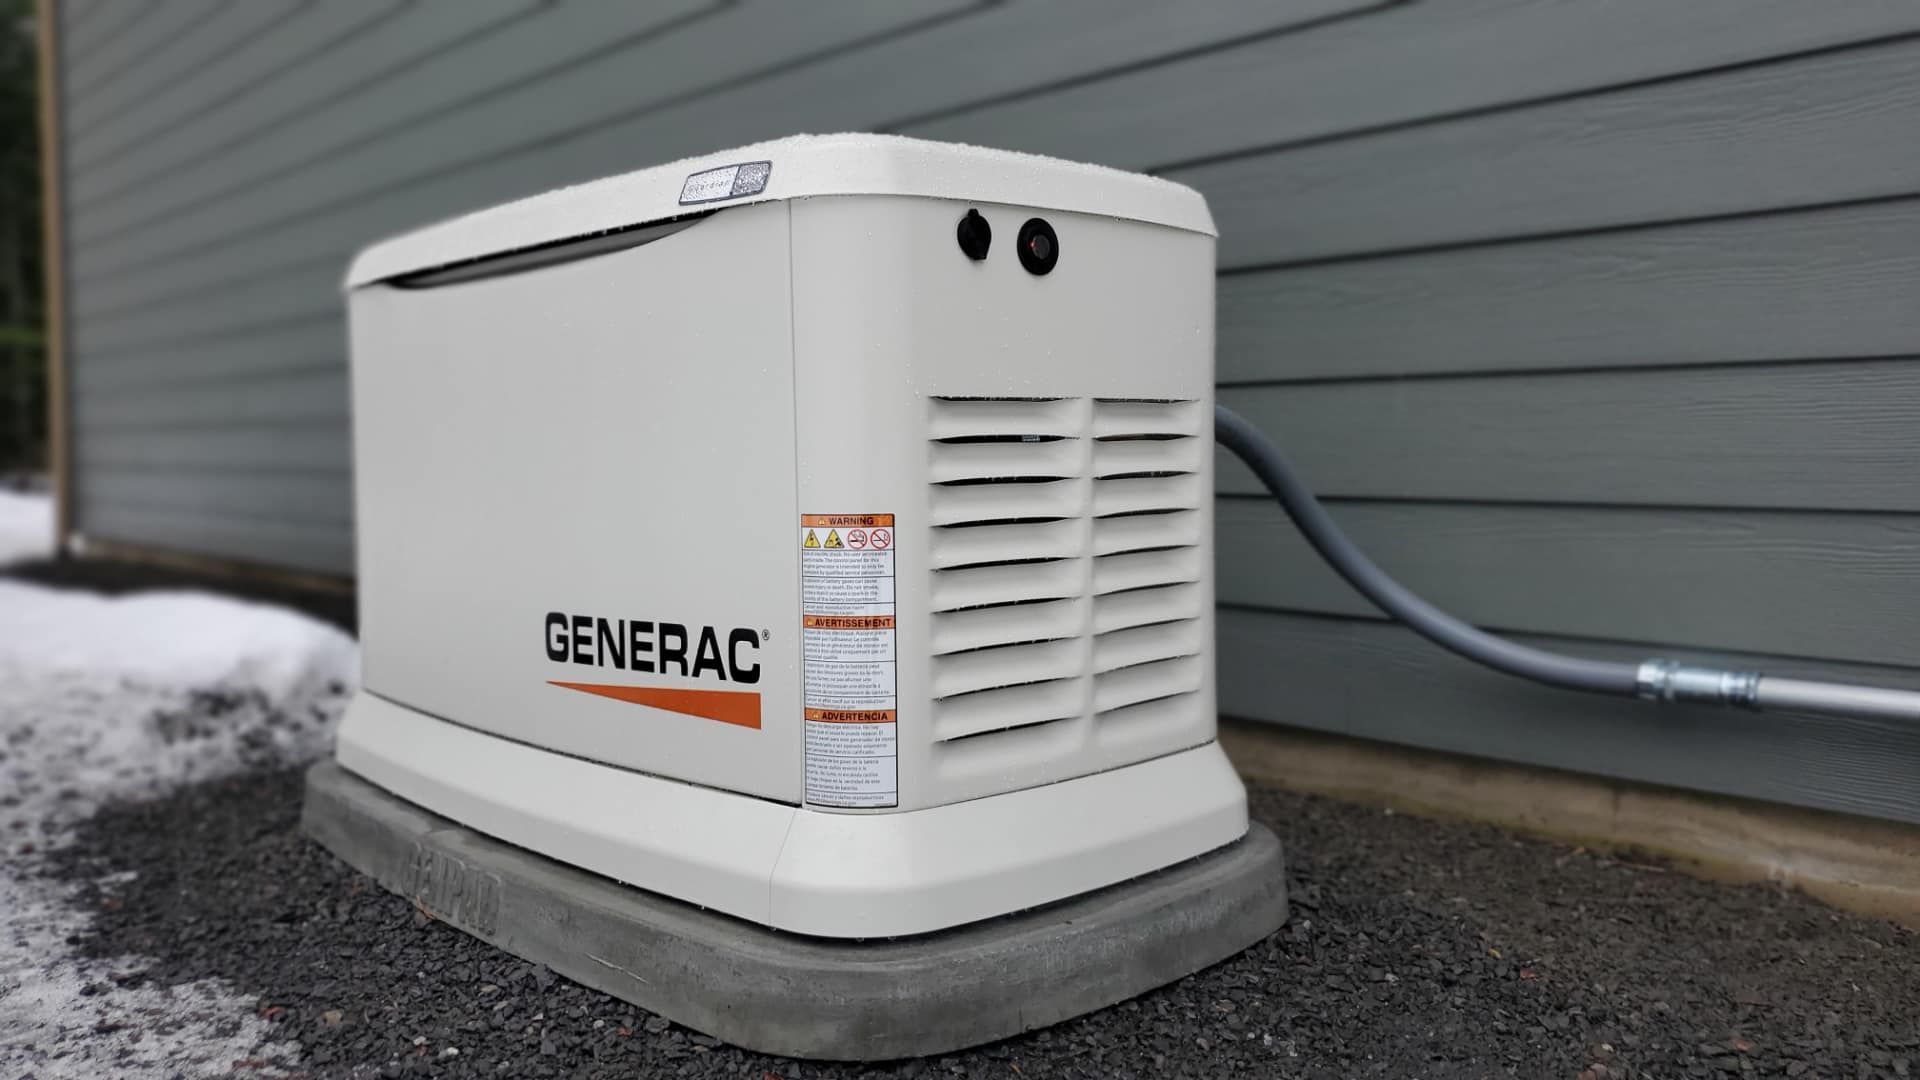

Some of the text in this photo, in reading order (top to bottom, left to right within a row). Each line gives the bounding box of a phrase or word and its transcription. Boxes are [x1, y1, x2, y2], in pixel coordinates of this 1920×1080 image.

[828, 516, 874, 525] WARNING
[815, 618, 891, 627] AVERTISSEMENT
[822, 711, 888, 721] ADVERTENCIA
